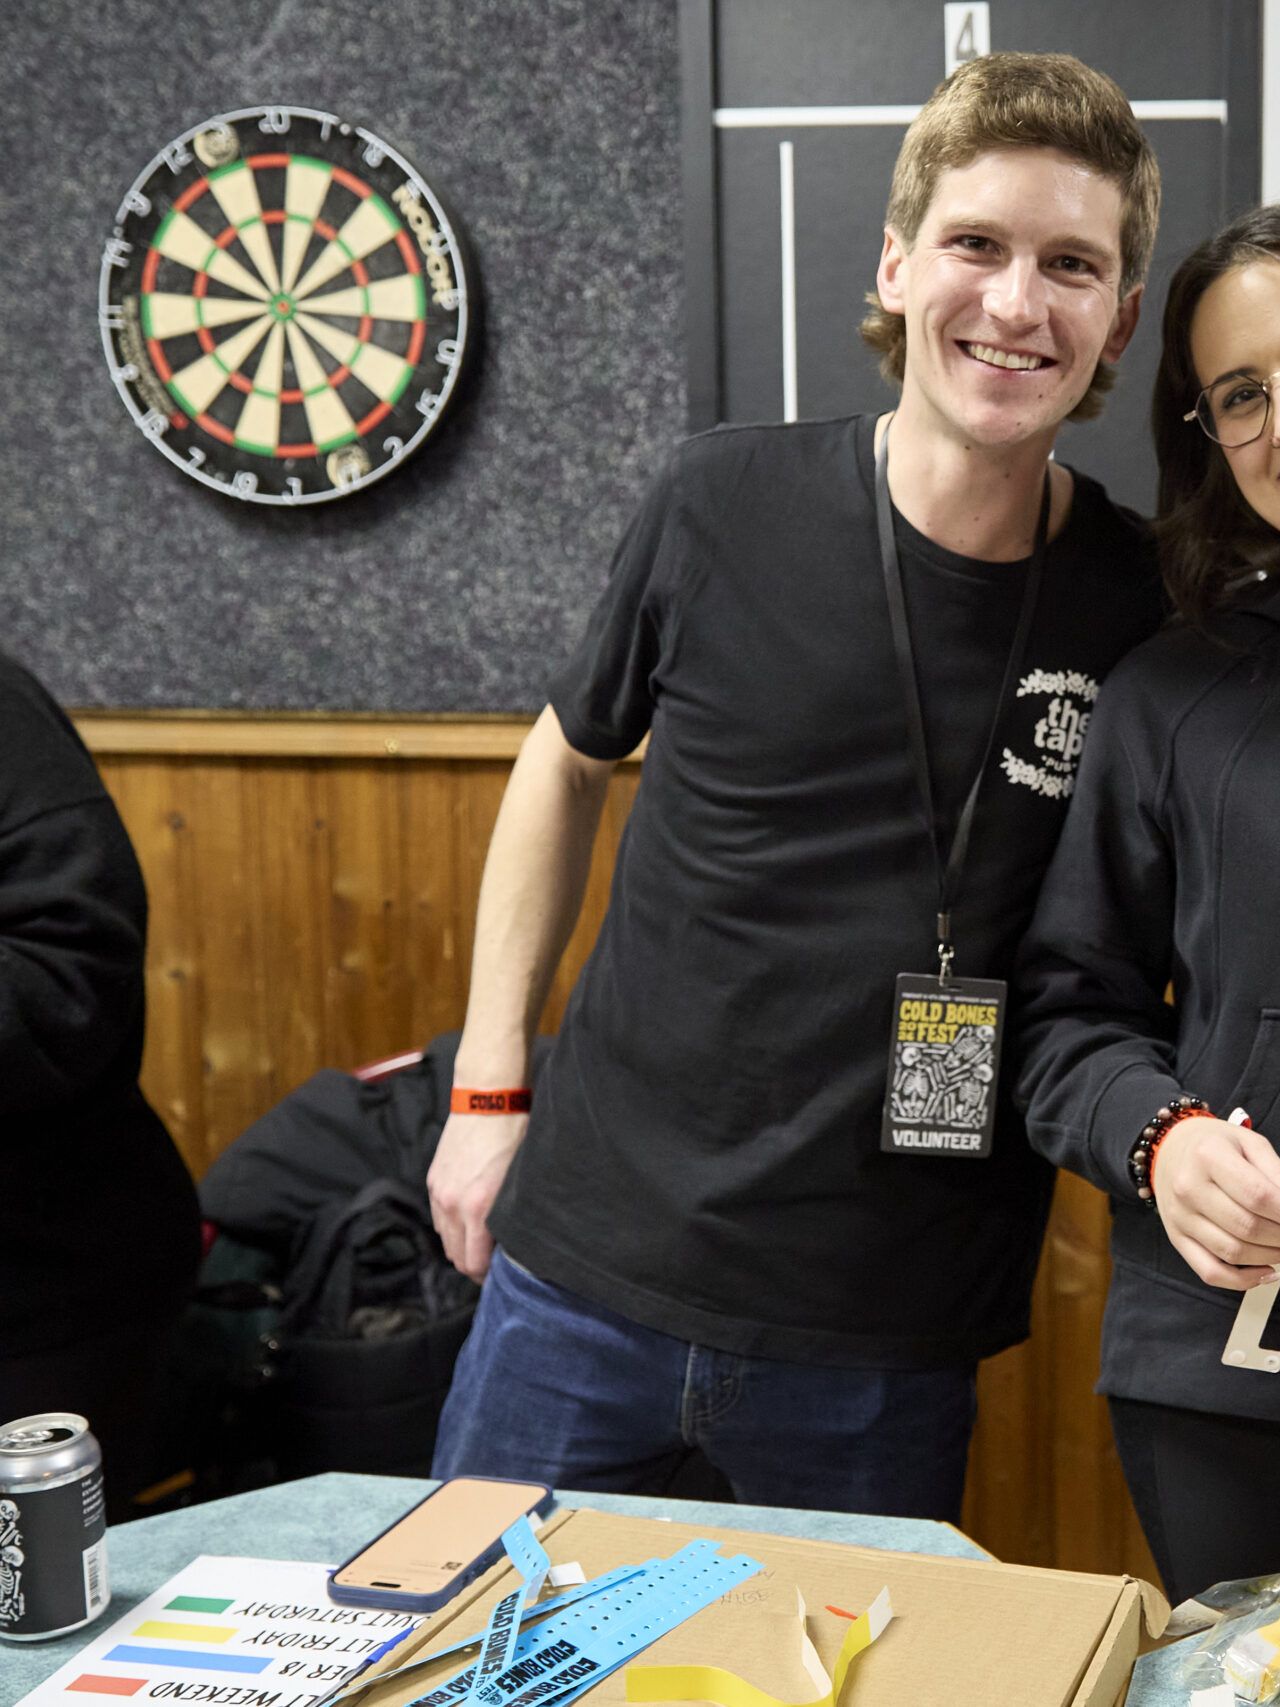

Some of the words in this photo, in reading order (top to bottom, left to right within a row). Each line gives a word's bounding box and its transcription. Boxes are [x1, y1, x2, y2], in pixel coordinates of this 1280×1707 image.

[900, 1000, 943, 1023] COLD
[945, 1004, 998, 1027] BONES
[917, 1023, 959, 1043] FEST
[469, 1094, 506, 1110] COLD
[892, 1129, 983, 1150] VOLUNTEER
[233, 1601, 367, 1627] SATURDAY
[492, 1591, 521, 1629] COLD
[242, 1629, 331, 1651] FRIDAY
[480, 1627, 512, 1675] BONES
[534, 1638, 580, 1670] COLD
[278, 1660, 307, 1677] 18
[444, 1666, 477, 1695] OLD
[493, 1658, 547, 1695] BONES
[549, 1657, 601, 1686] COLD
[148, 1680, 284, 1707] WEEKEND
